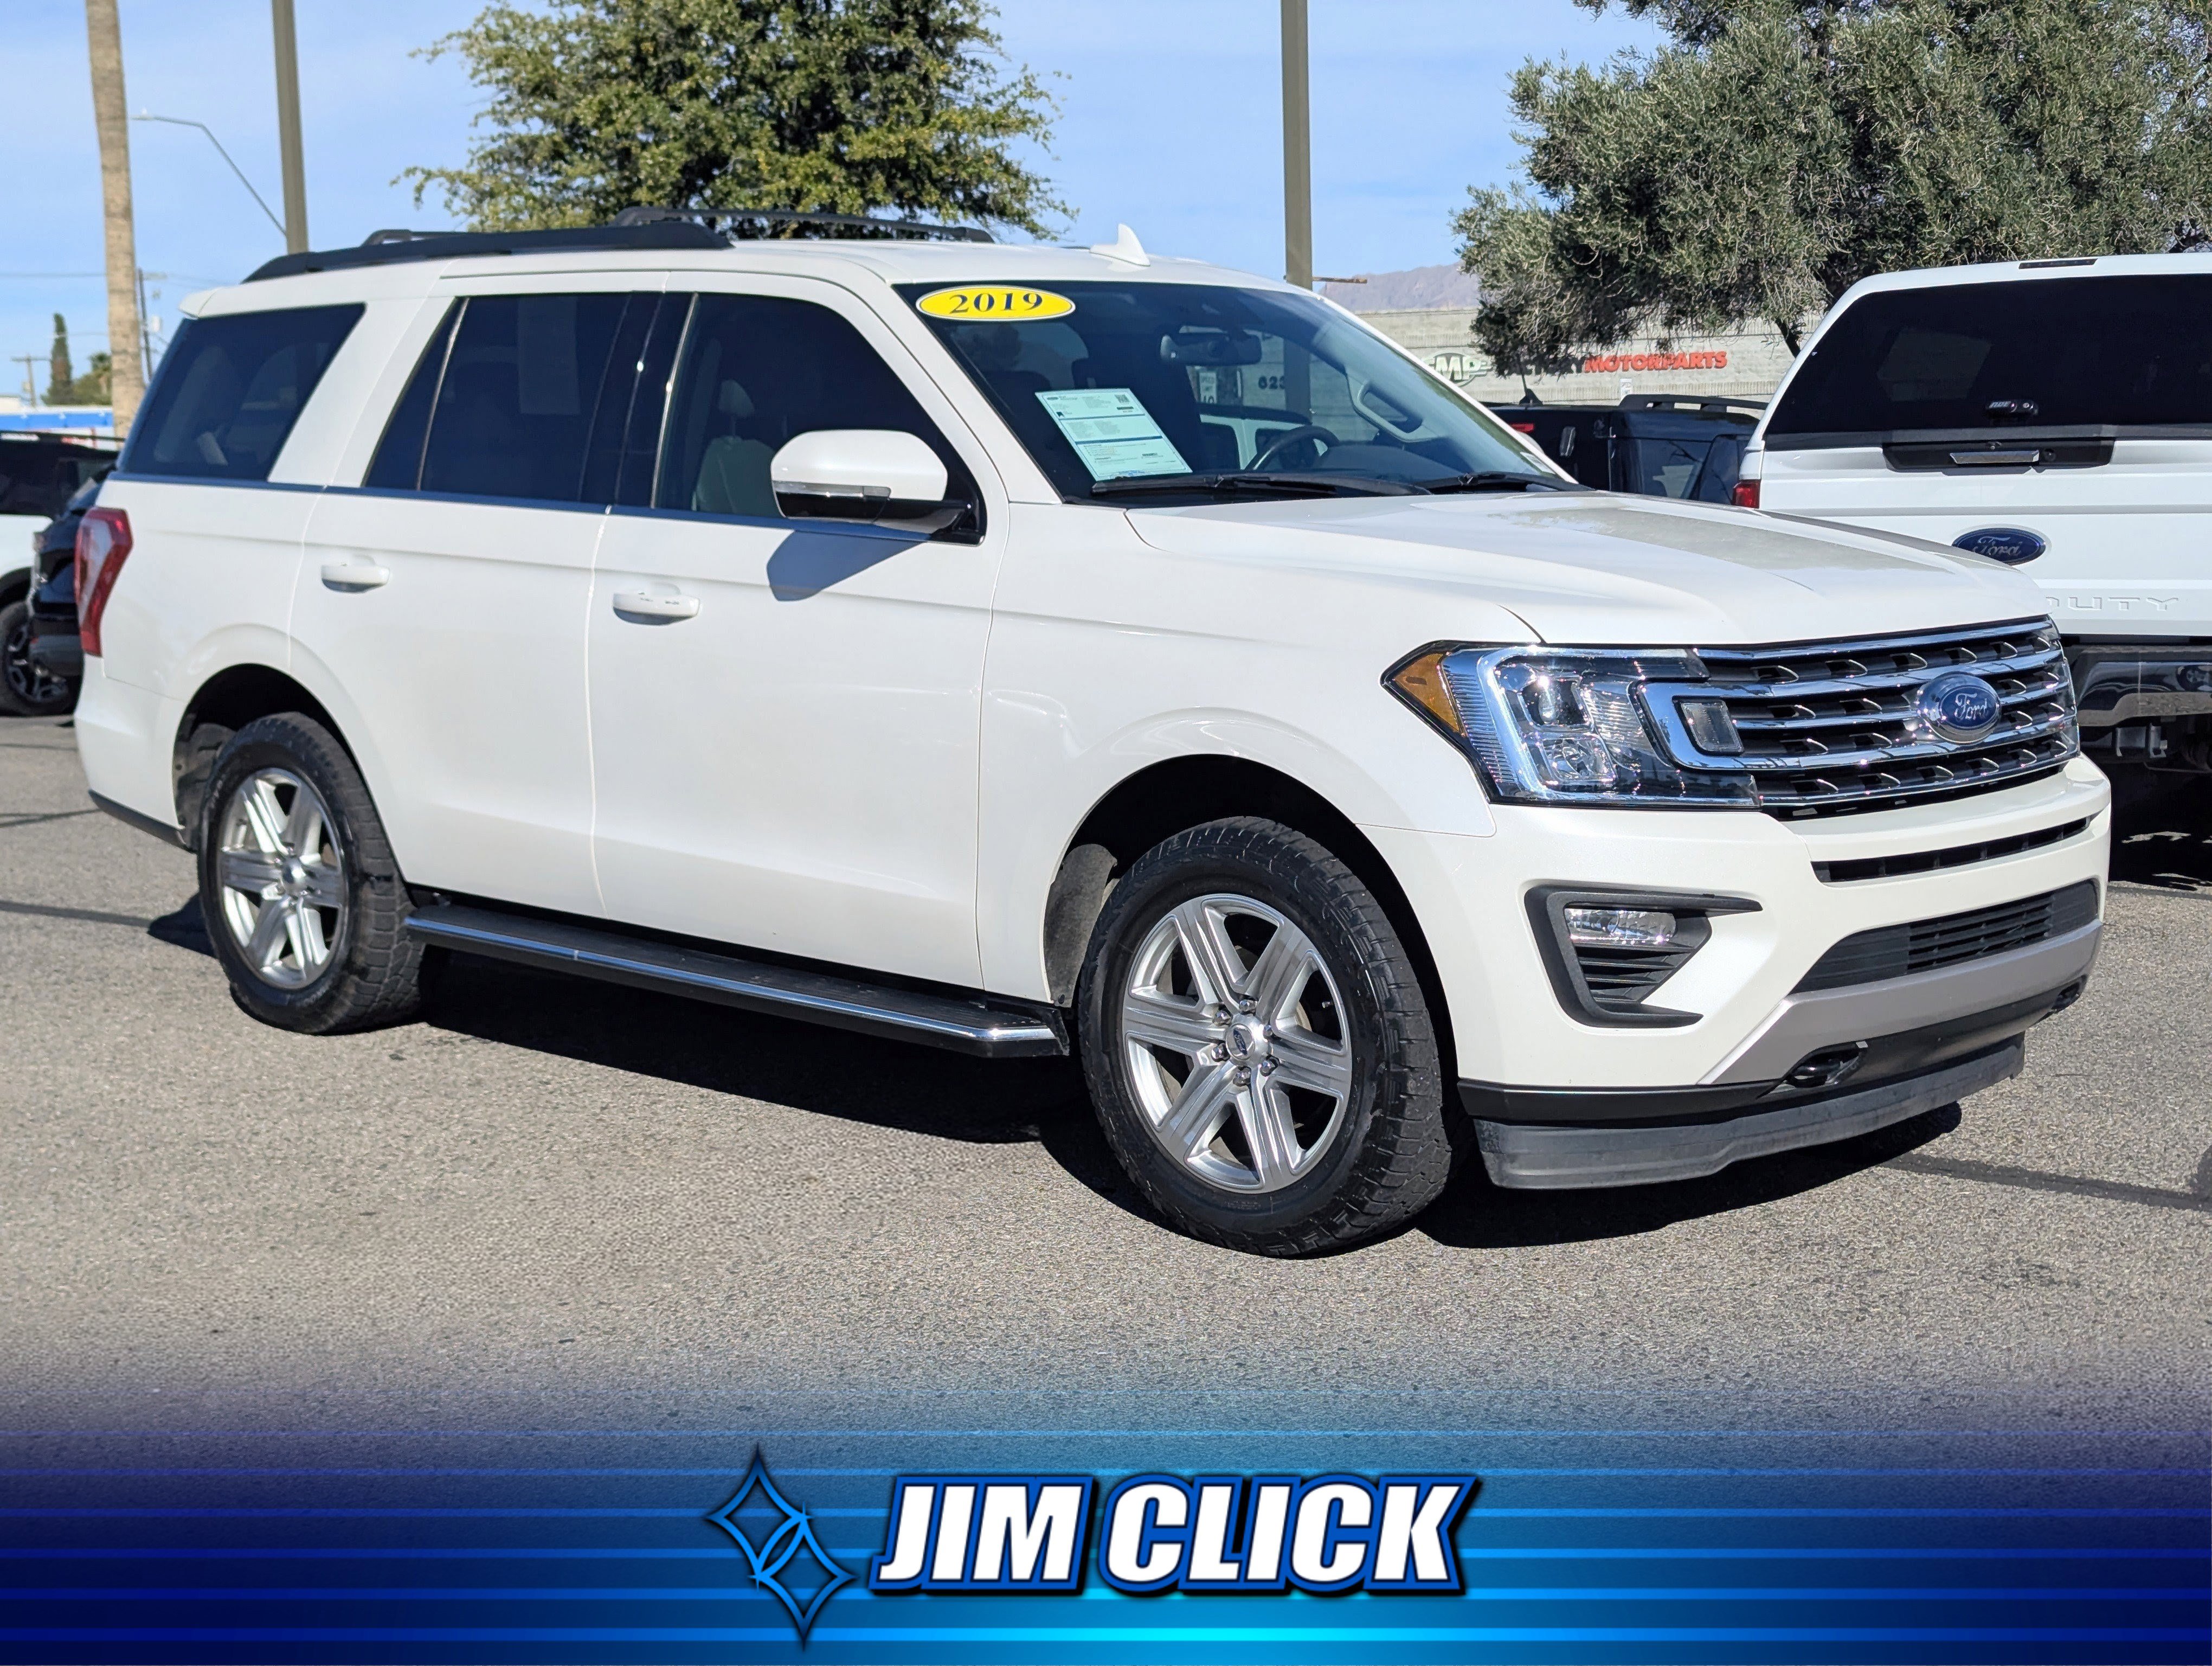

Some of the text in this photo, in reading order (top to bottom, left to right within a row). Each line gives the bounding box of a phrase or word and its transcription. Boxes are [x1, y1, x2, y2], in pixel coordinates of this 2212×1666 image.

[949, 292, 1043, 314] 2019
[1584, 351, 1728, 373] MOTORPARTS
[1973, 536, 2023, 556] Ford
[1954, 692, 1988, 720] Ford
[1233, 1034, 1246, 1052] Ford
